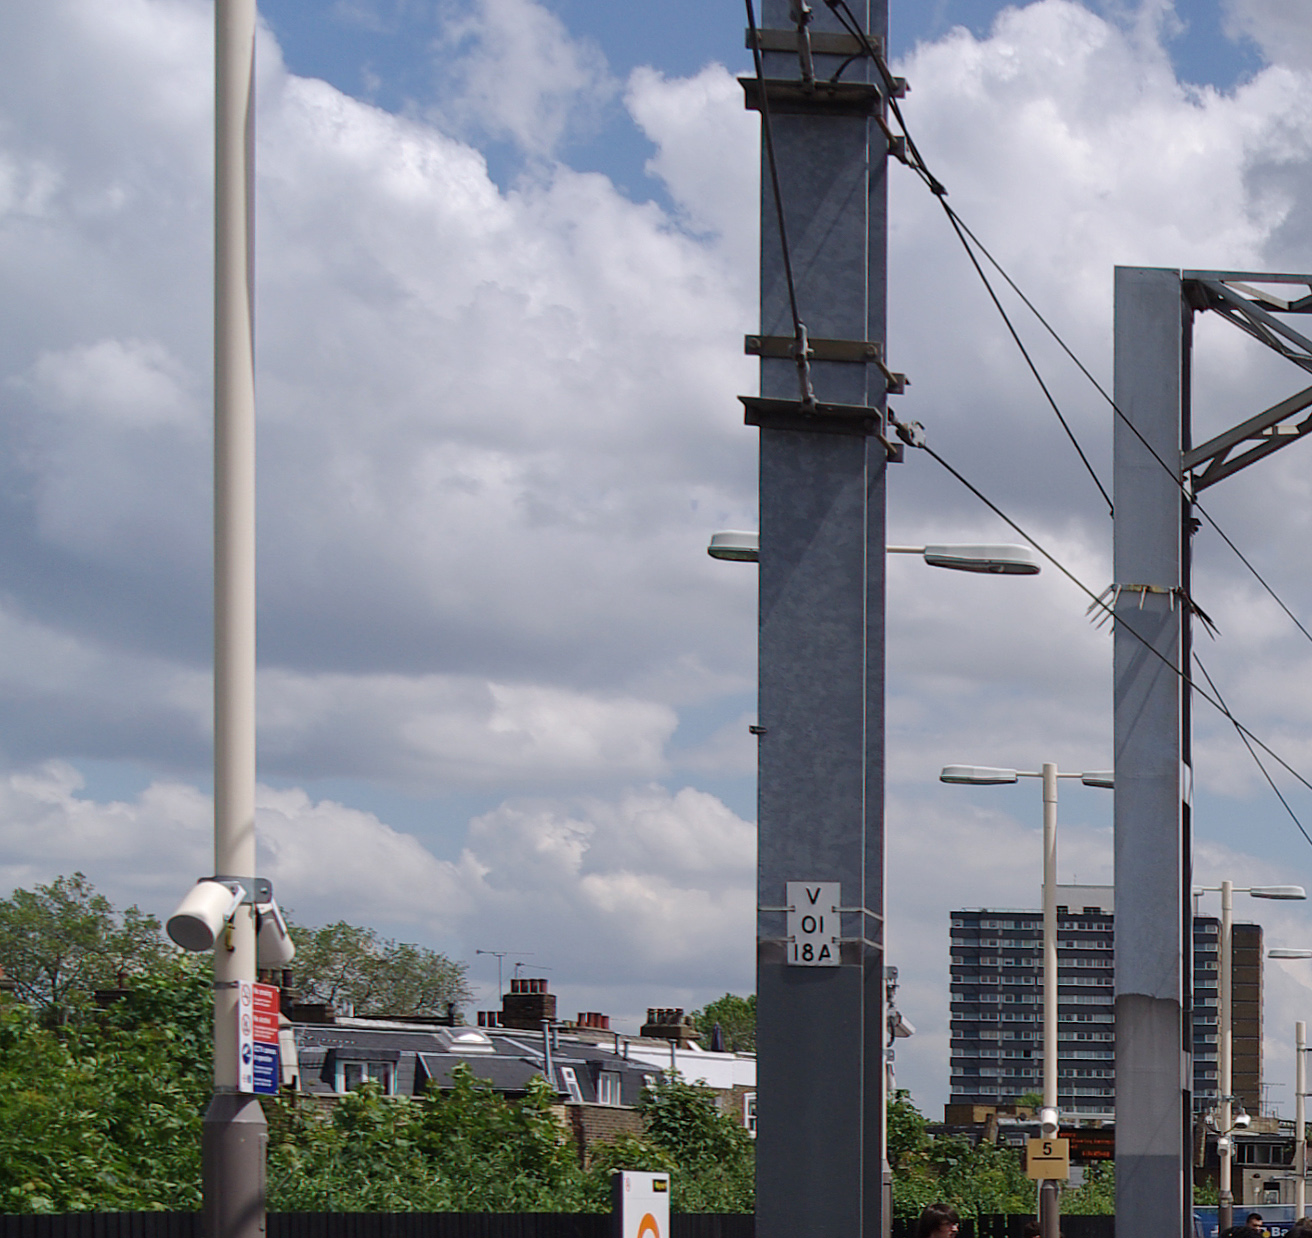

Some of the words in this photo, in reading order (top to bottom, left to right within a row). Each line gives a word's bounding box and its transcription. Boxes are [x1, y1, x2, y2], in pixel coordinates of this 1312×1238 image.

[806, 887, 821, 905] V
[795, 943, 831, 962] 18A
[1043, 1142, 1052, 1155] 5
